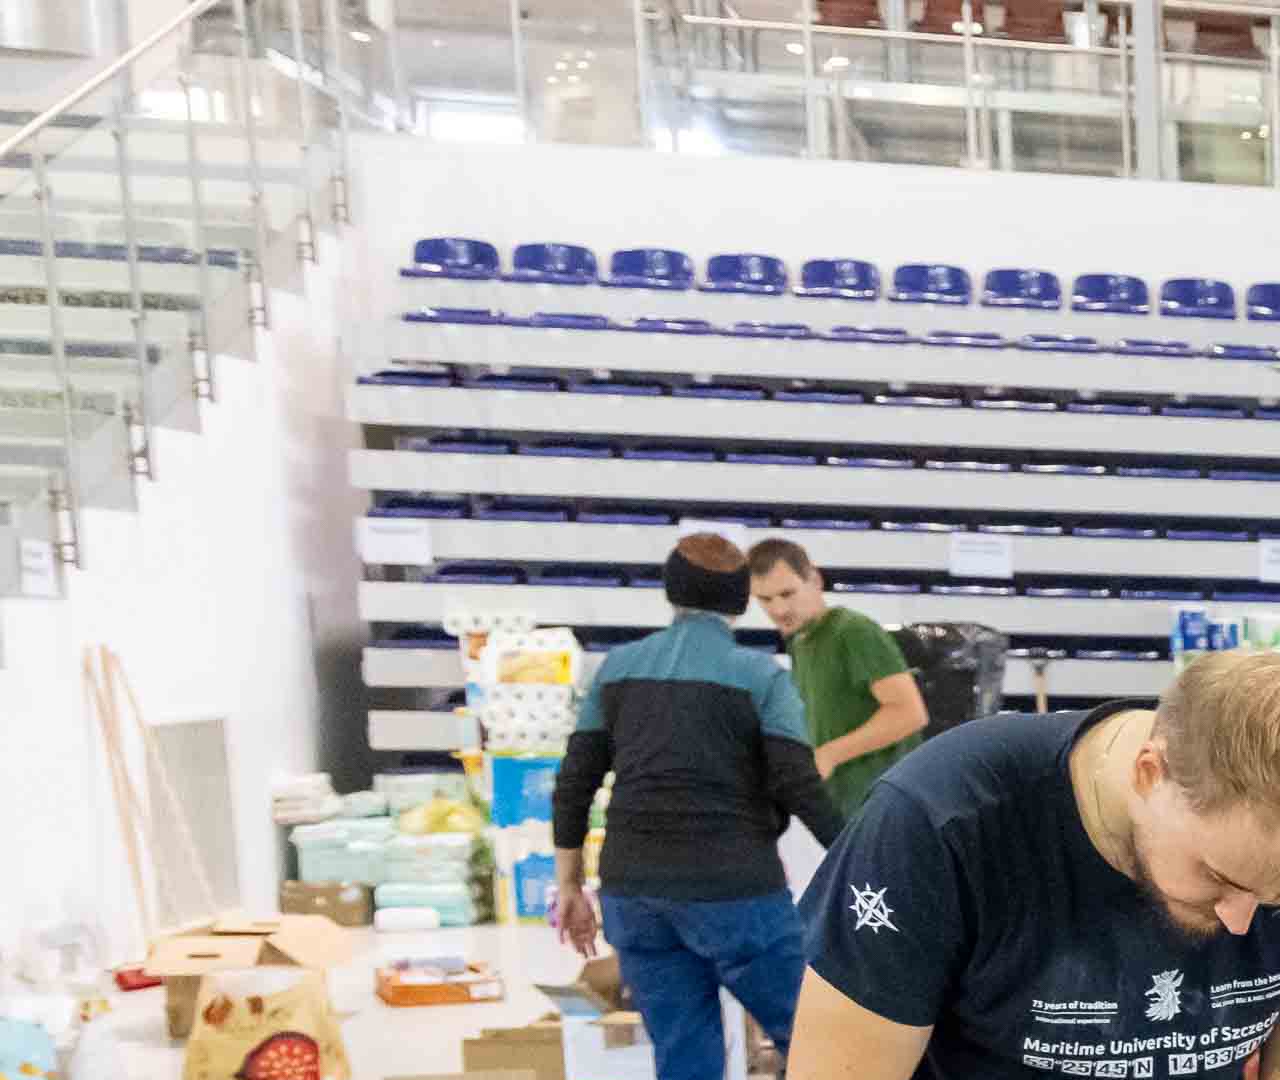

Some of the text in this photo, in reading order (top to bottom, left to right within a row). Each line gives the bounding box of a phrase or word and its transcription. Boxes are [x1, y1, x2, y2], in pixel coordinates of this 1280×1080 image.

[1023, 1037, 1106, 1056] Maritime
[1110, 1031, 1196, 1055] University
[1200, 1027, 1219, 1046] of
